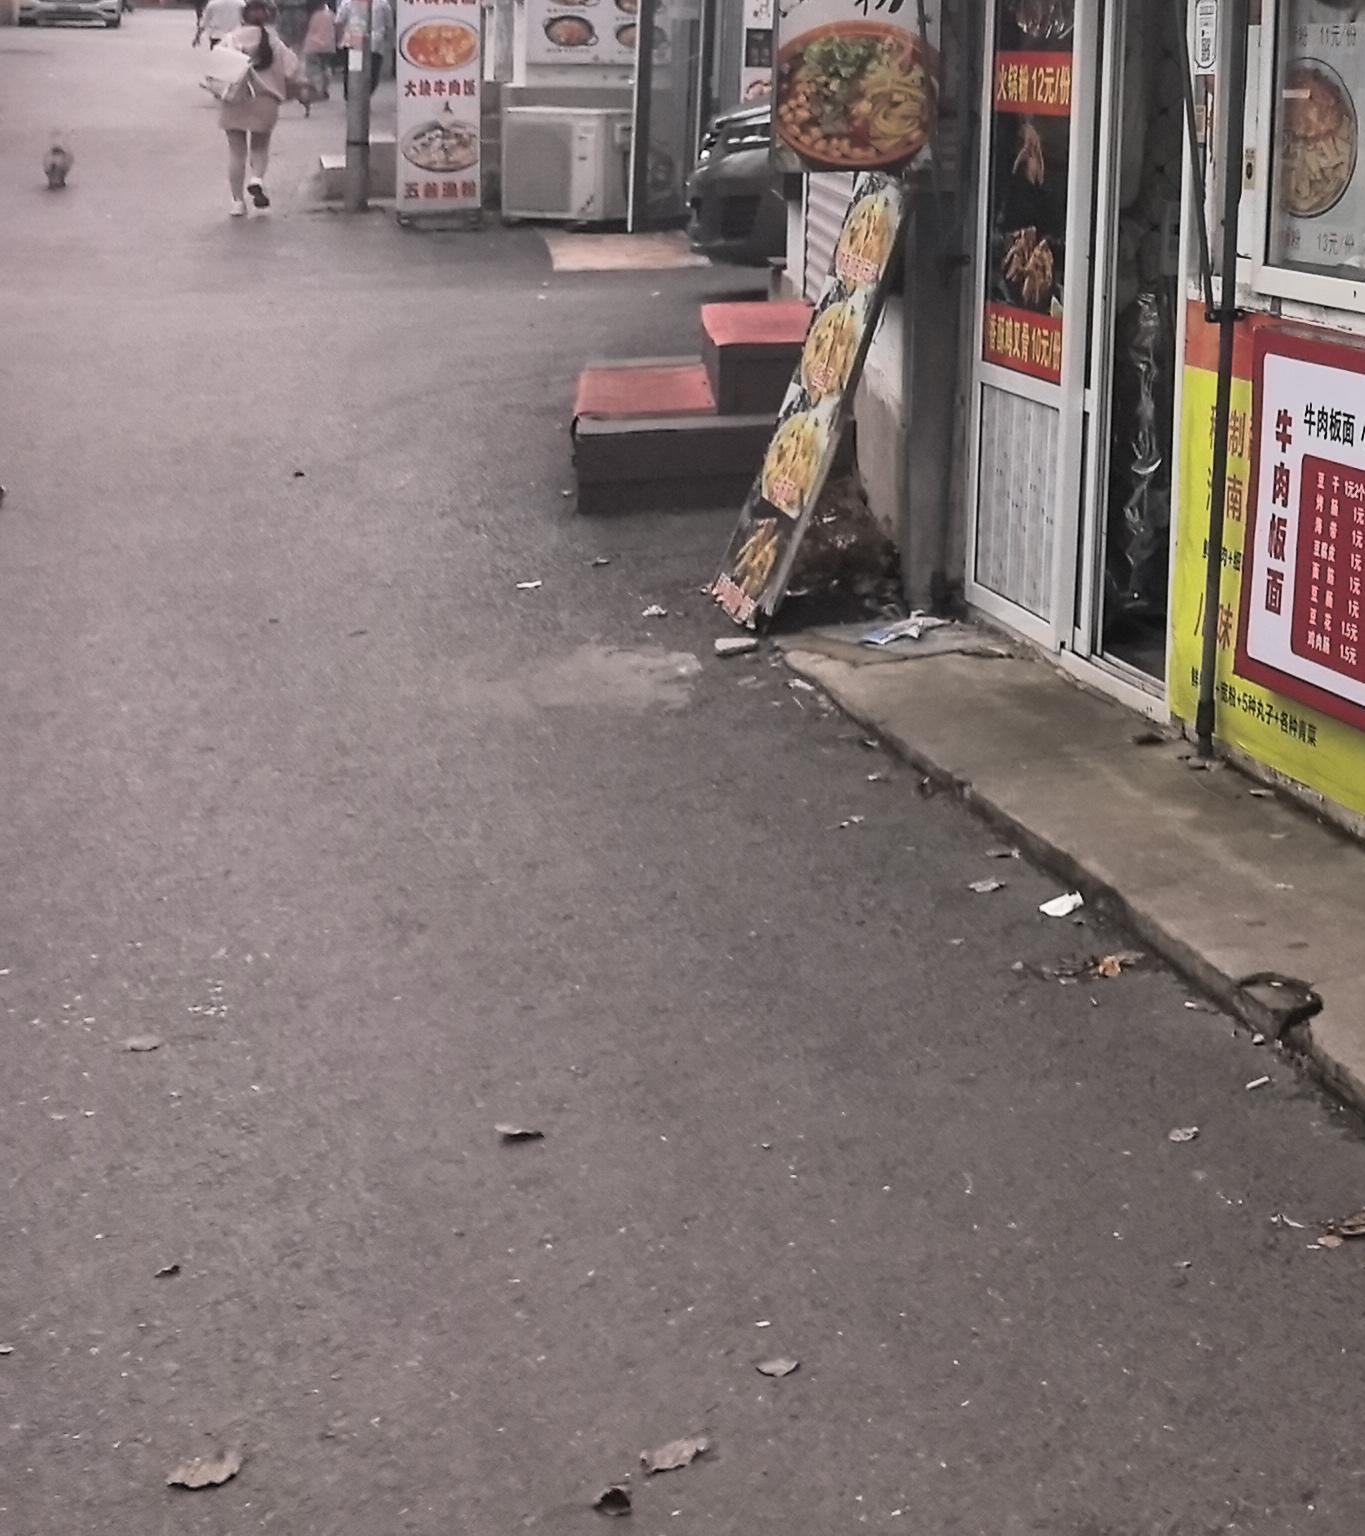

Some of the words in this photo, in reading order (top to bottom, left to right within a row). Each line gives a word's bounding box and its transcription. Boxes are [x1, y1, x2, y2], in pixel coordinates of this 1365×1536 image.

[1032, 66, 1070, 104] 12元/份
[1304, 403, 1355, 447] 牛肉板面
[1265, 409, 1292, 616] 牛肉板面
[1353, 507, 1365, 525] 1元
[1352, 530, 1363, 549] 1元
[1351, 553, 1362, 572] 1元
[1350, 577, 1361, 595] 1元
[1348, 600, 1359, 619] 1元
